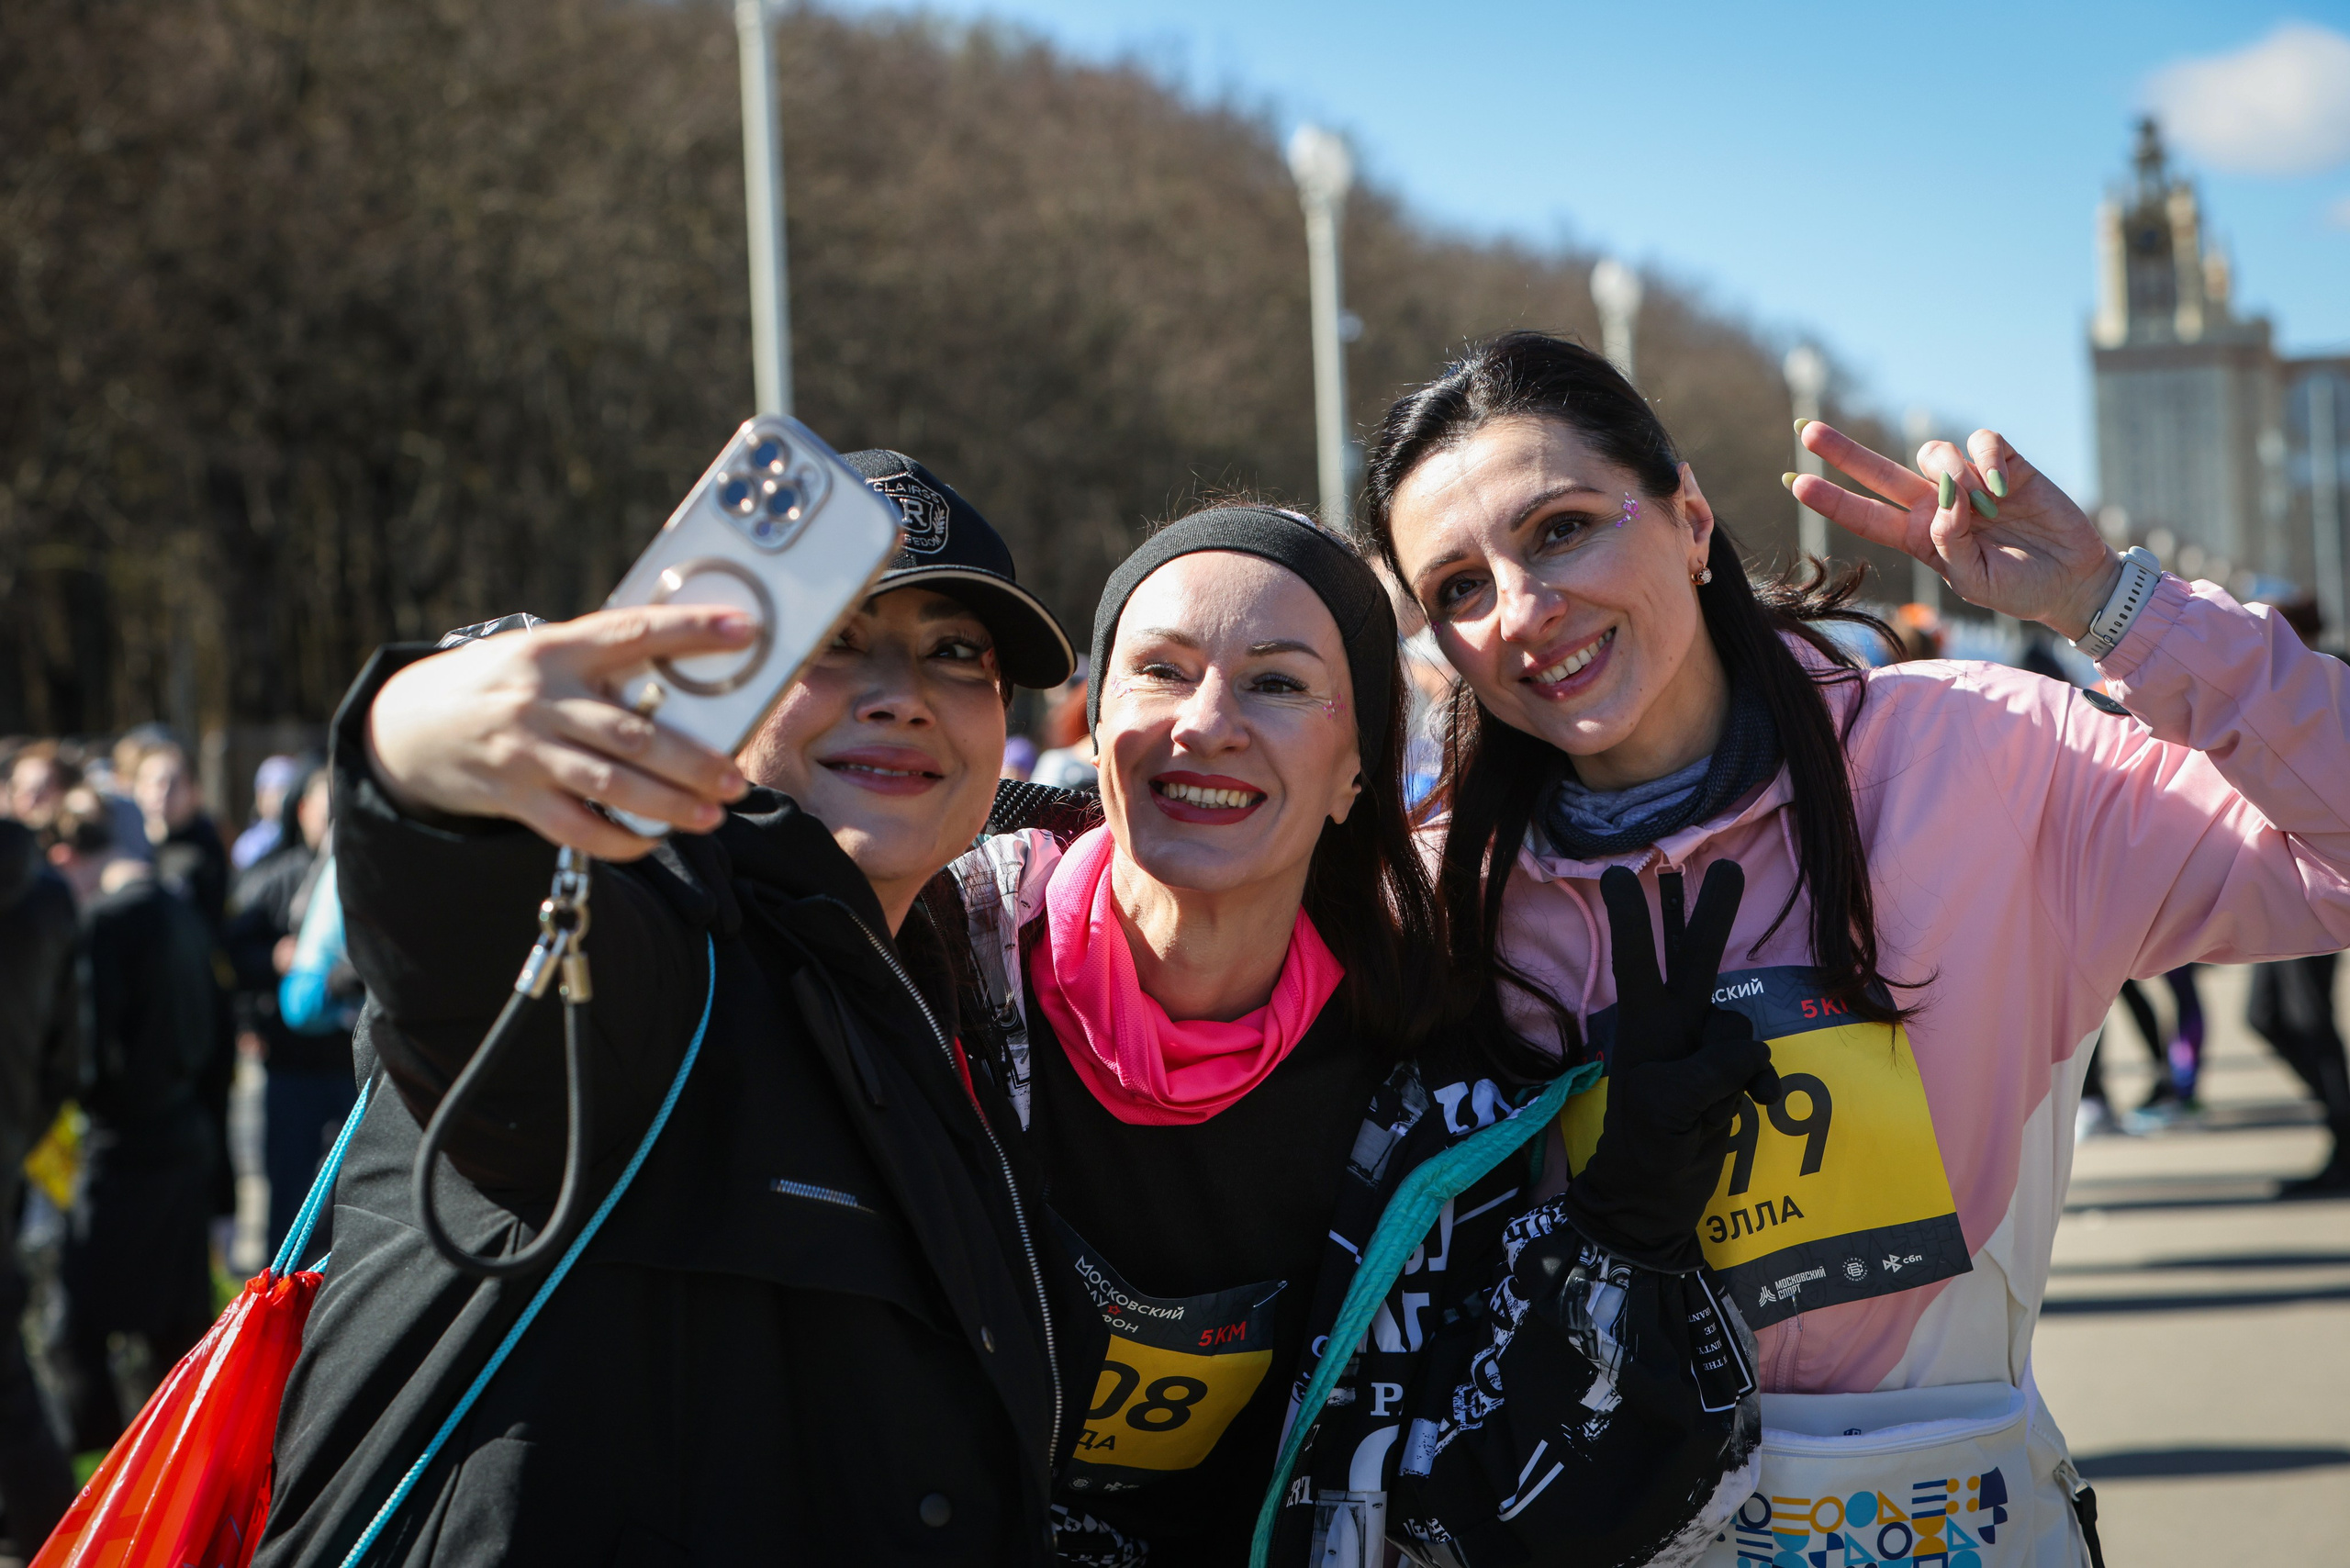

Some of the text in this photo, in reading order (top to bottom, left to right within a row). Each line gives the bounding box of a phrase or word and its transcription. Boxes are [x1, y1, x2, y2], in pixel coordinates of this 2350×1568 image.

[899, 498, 927, 527] R
[1706, 1194, 1806, 1244] ЭЛЛА
[1903, 1254, 1923, 1265] сбп
[1074, 1255, 1185, 1320] МОСКОВСКИЙ
[1774, 1266, 1827, 1290] МОСКОВСКИЙ
[1777, 1283, 1801, 1300] СПОРТ
